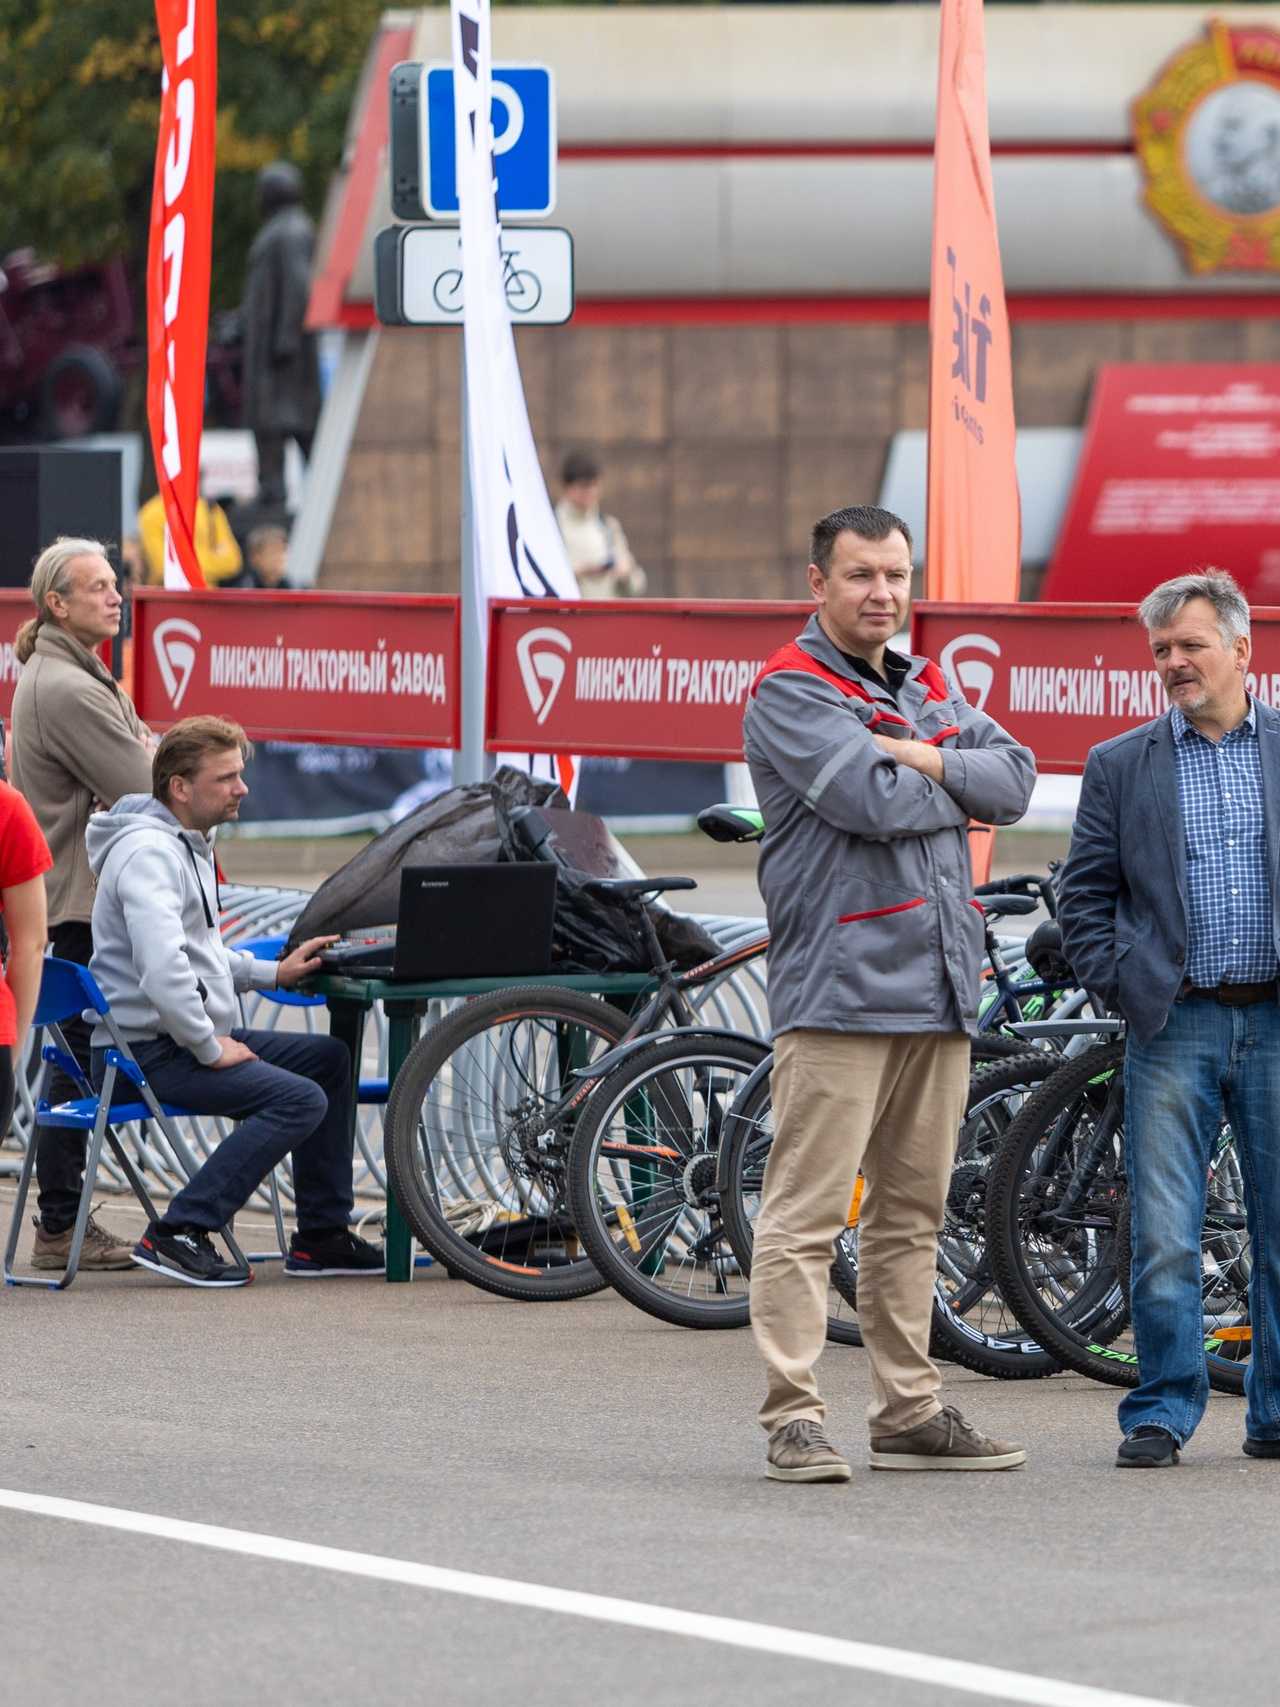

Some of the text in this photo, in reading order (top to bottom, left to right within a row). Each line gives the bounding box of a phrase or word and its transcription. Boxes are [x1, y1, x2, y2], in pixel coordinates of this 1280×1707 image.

[210, 635, 446, 704] МИНСКИЙ ТРАКТОРНЫЙ ЗАВОД
[575, 644, 768, 704] МИНСКИЙ ТРАКТОРН
[1009, 654, 1104, 716] МИНСКИЙ
[1107, 669, 1172, 718] ТРАКТ
